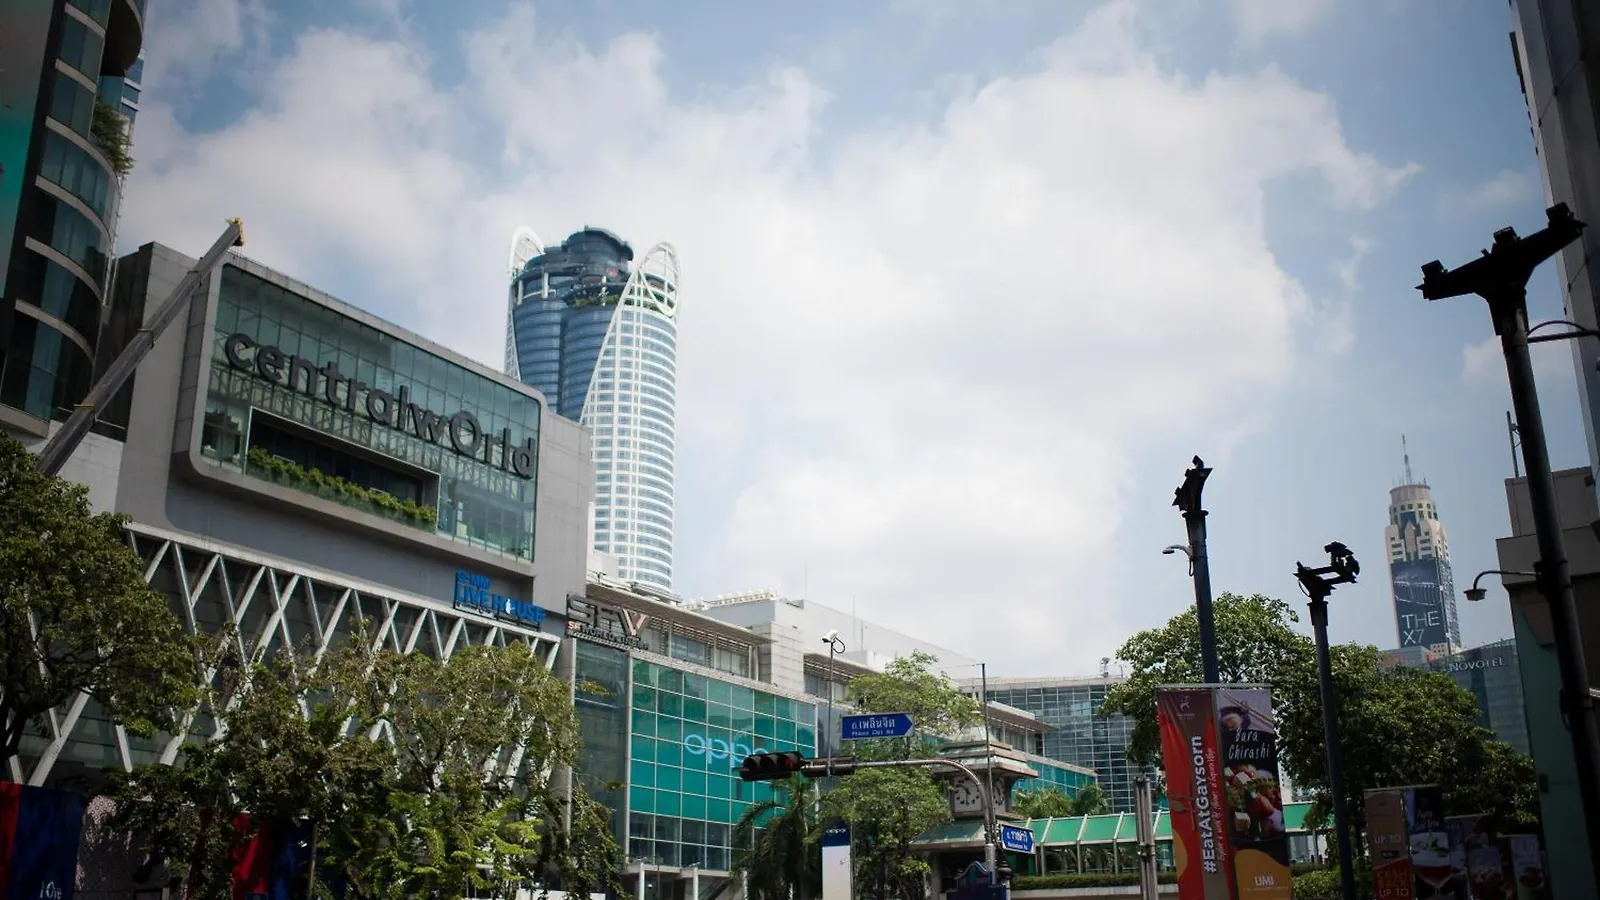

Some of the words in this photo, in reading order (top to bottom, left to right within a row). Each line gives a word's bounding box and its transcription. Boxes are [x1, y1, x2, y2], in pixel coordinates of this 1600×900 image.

[456, 580, 489, 606] LIVE
[1402, 610, 1441, 629] THE
[1404, 628, 1425, 645] X7
[1449, 657, 1506, 672] NOVOTEL
[1228, 742, 1270, 760] Chirashi
[1190, 735, 1217, 873] #EatAtGaysorn
[1373, 835, 1386, 845] UP
[1389, 834, 1402, 844] TO
[1378, 888, 1392, 898] UP
[1395, 887, 1409, 898] TO
